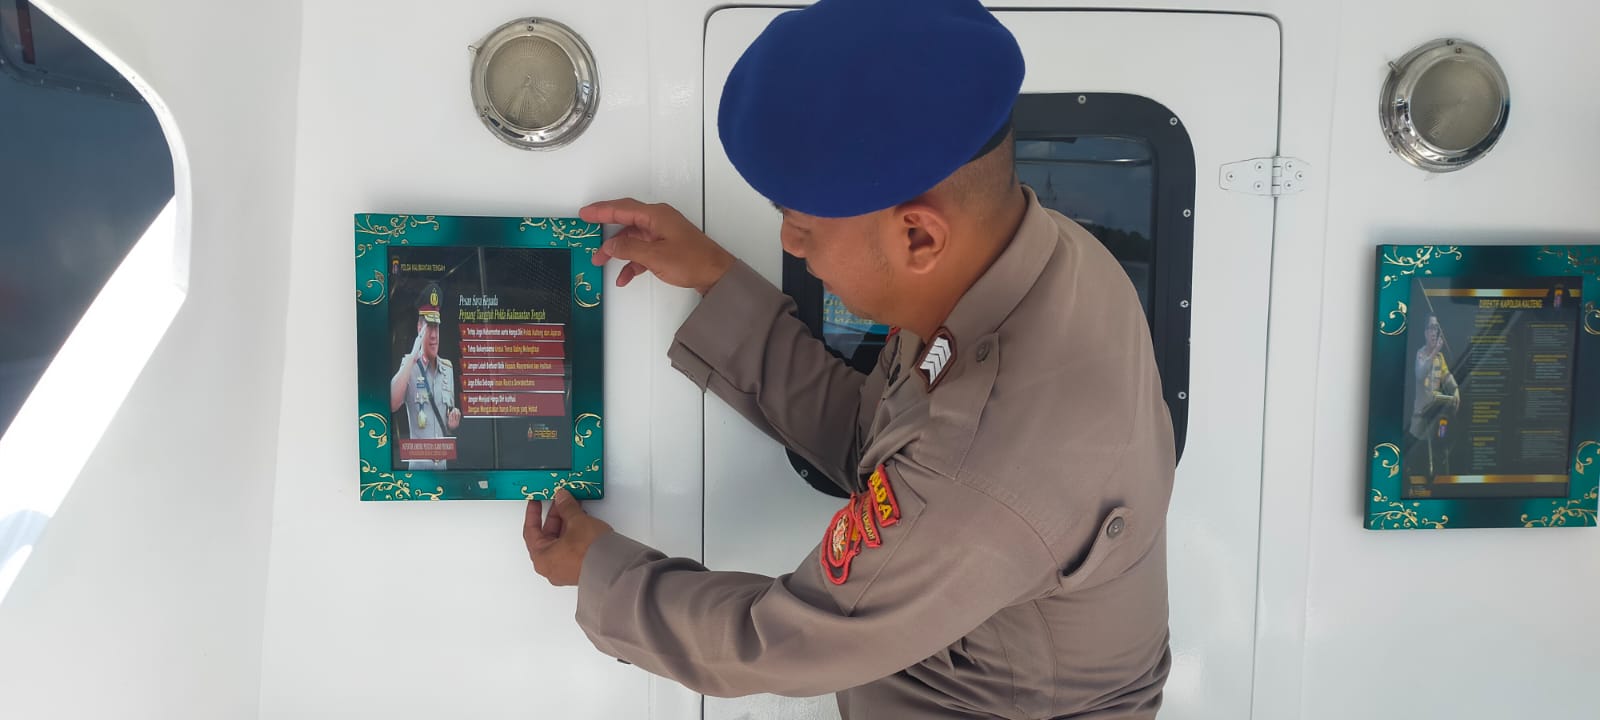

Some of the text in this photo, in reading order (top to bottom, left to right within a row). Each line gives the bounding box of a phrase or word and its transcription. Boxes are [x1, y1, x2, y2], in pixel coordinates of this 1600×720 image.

[459, 295, 472, 306] Pesan
[482, 295, 498, 309] Kepada
[495, 309, 506, 320] Polda
[507, 309, 530, 320] Kalimantan
[531, 309, 546, 322] Tengah
